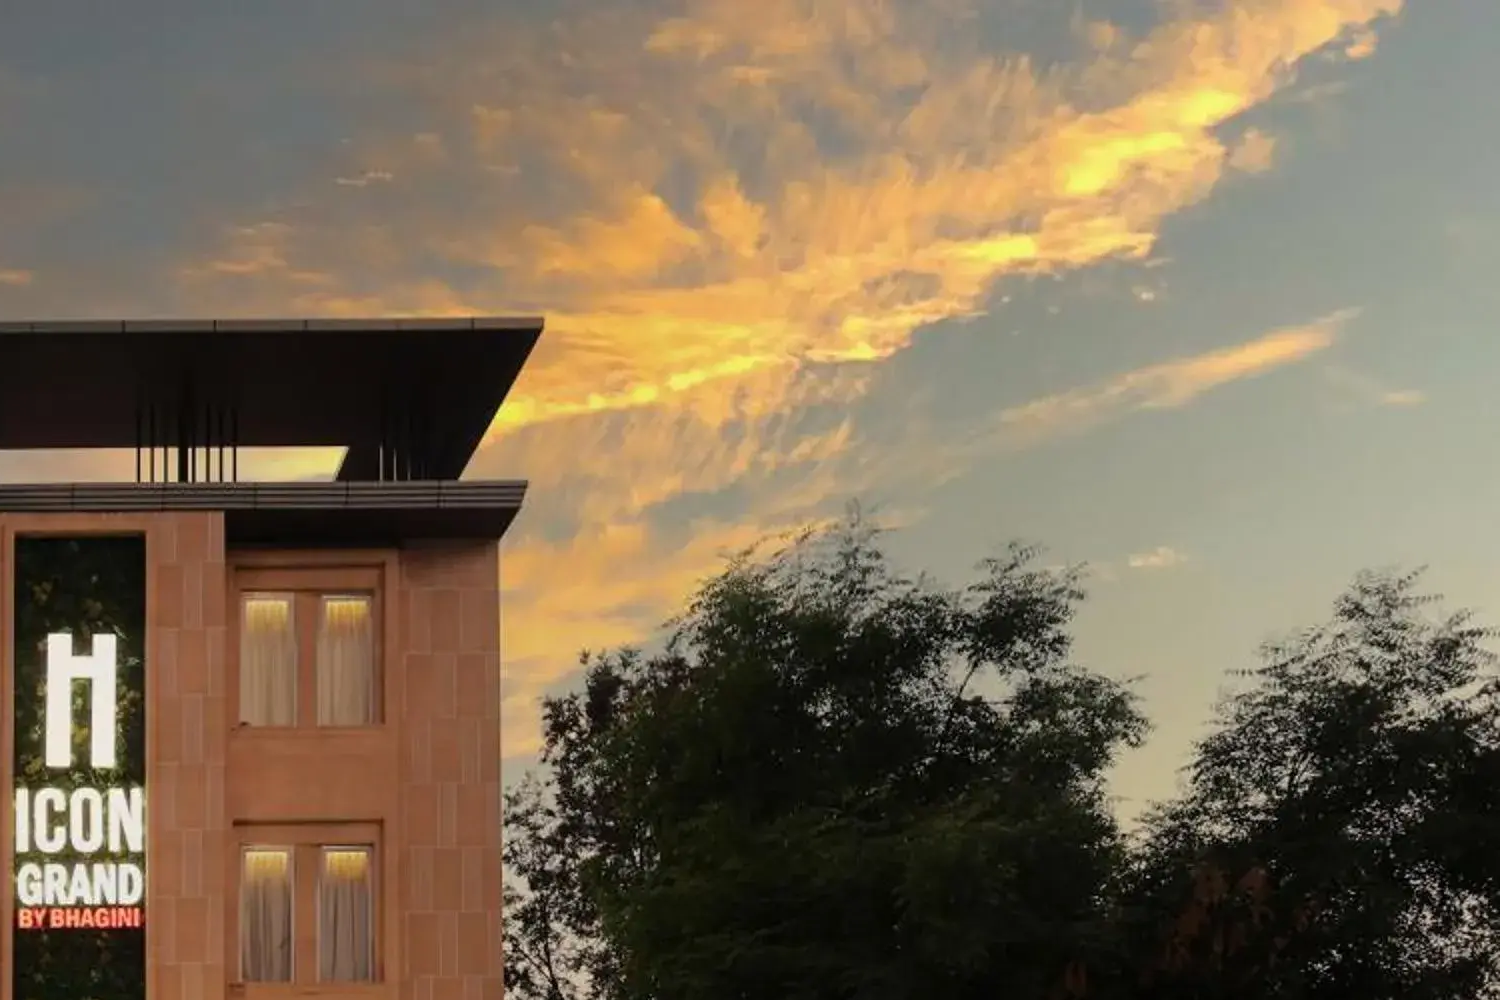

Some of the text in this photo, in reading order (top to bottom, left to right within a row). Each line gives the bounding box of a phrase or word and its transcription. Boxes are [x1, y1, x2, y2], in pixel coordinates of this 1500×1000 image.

[15, 787, 143, 853] ICON
[17, 863, 143, 906] GRAND
[19, 908, 140, 928] BY BHAGINI
